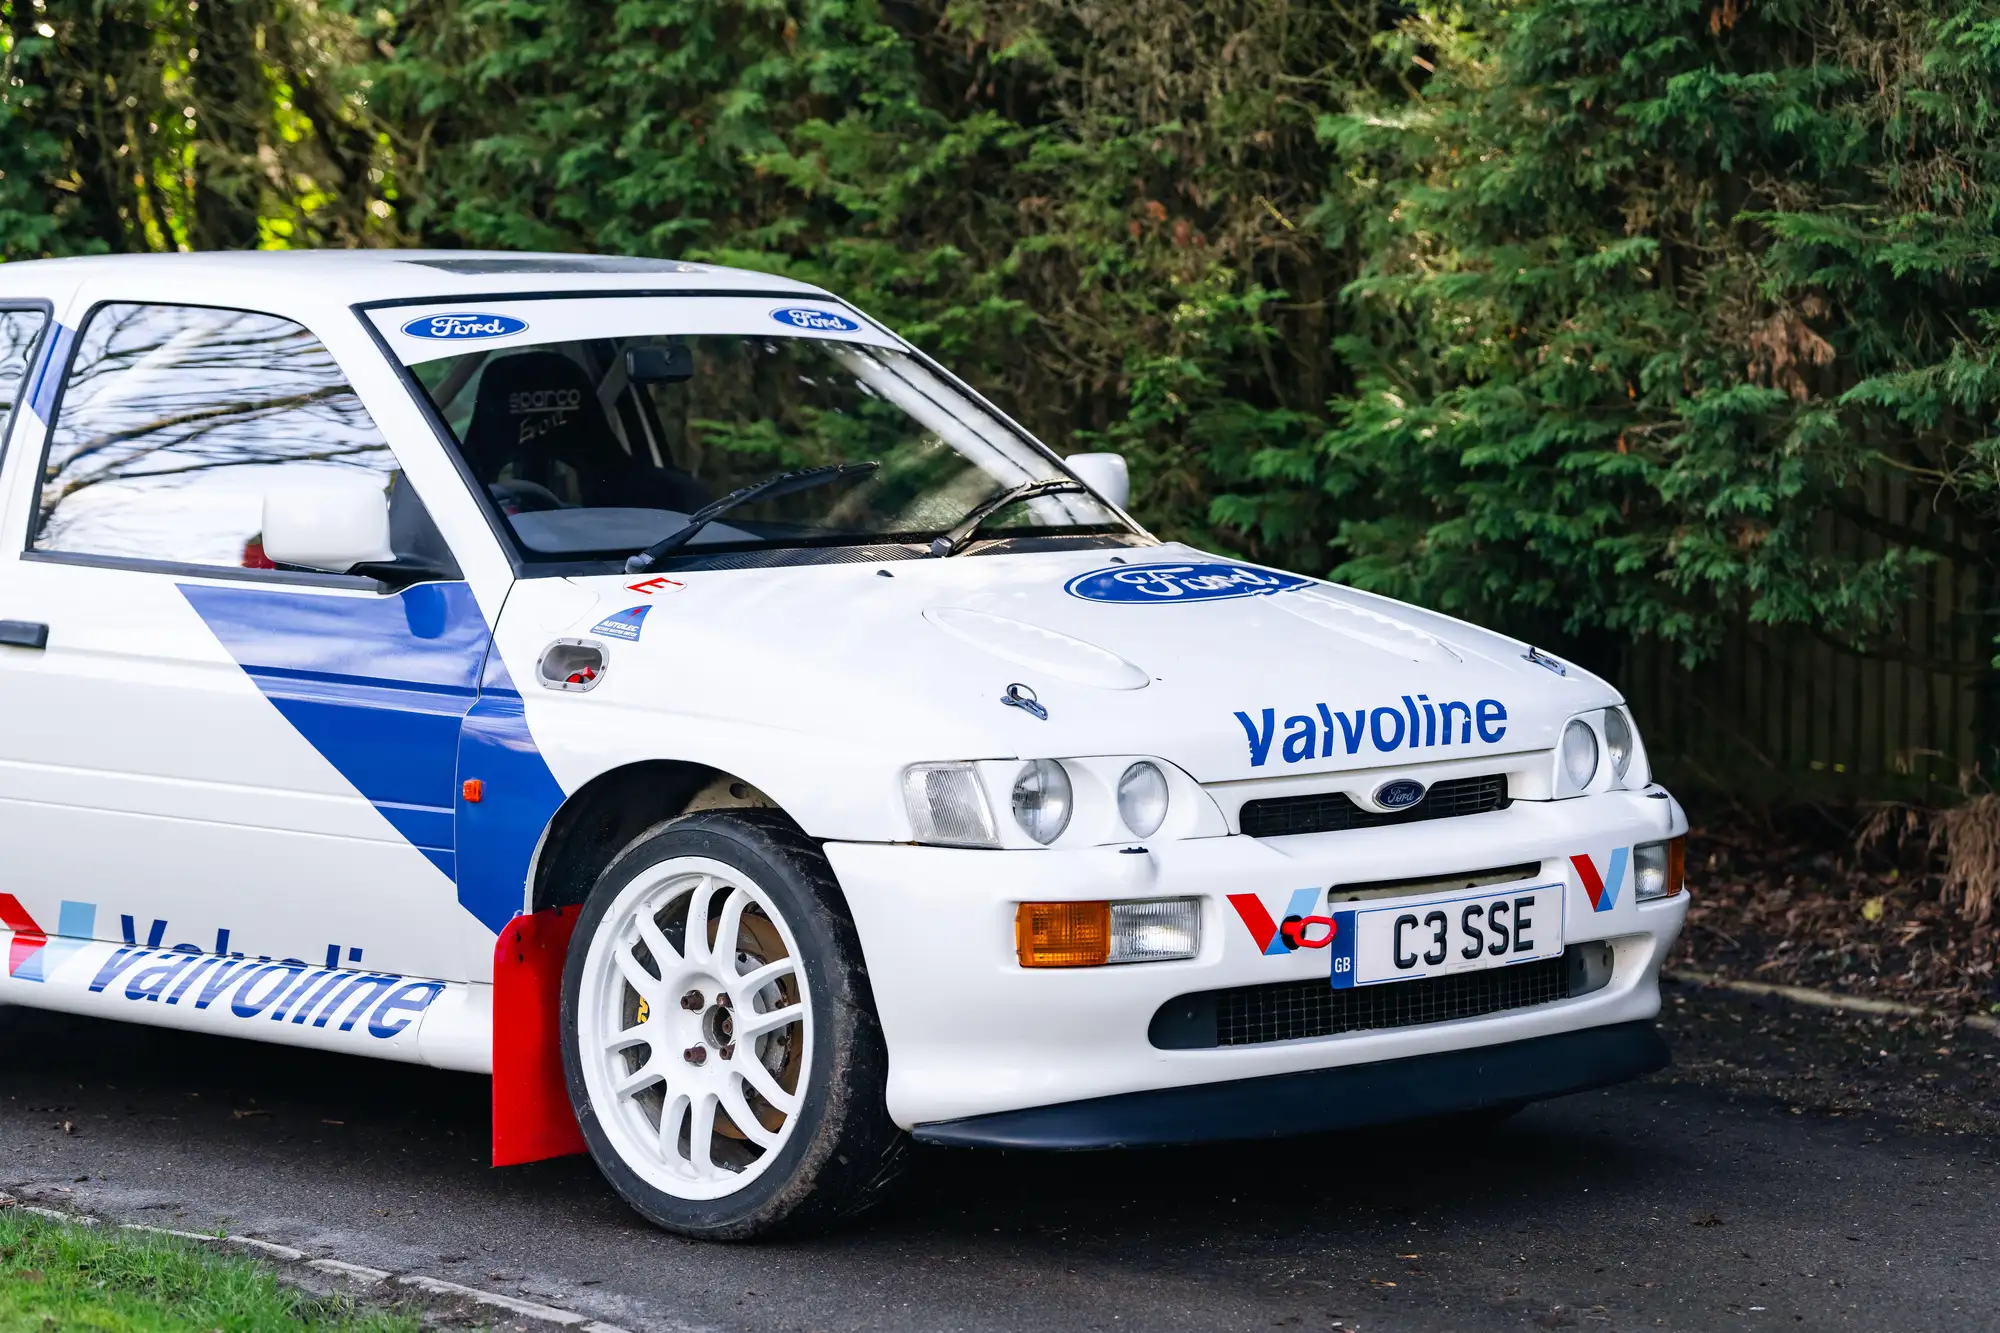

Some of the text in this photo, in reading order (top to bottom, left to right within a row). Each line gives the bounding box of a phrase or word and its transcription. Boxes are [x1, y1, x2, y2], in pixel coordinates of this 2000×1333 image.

[430, 315, 506, 338] Ford
[788, 308, 848, 332] Ford
[508, 389, 581, 413] sparco
[1113, 566, 1280, 597] Ford
[1232, 693, 1508, 768] Valvoline
[1393, 895, 1536, 970] C3 SSE
[88, 914, 447, 1040] Valvoline
[1334, 956, 1351, 973] GB
